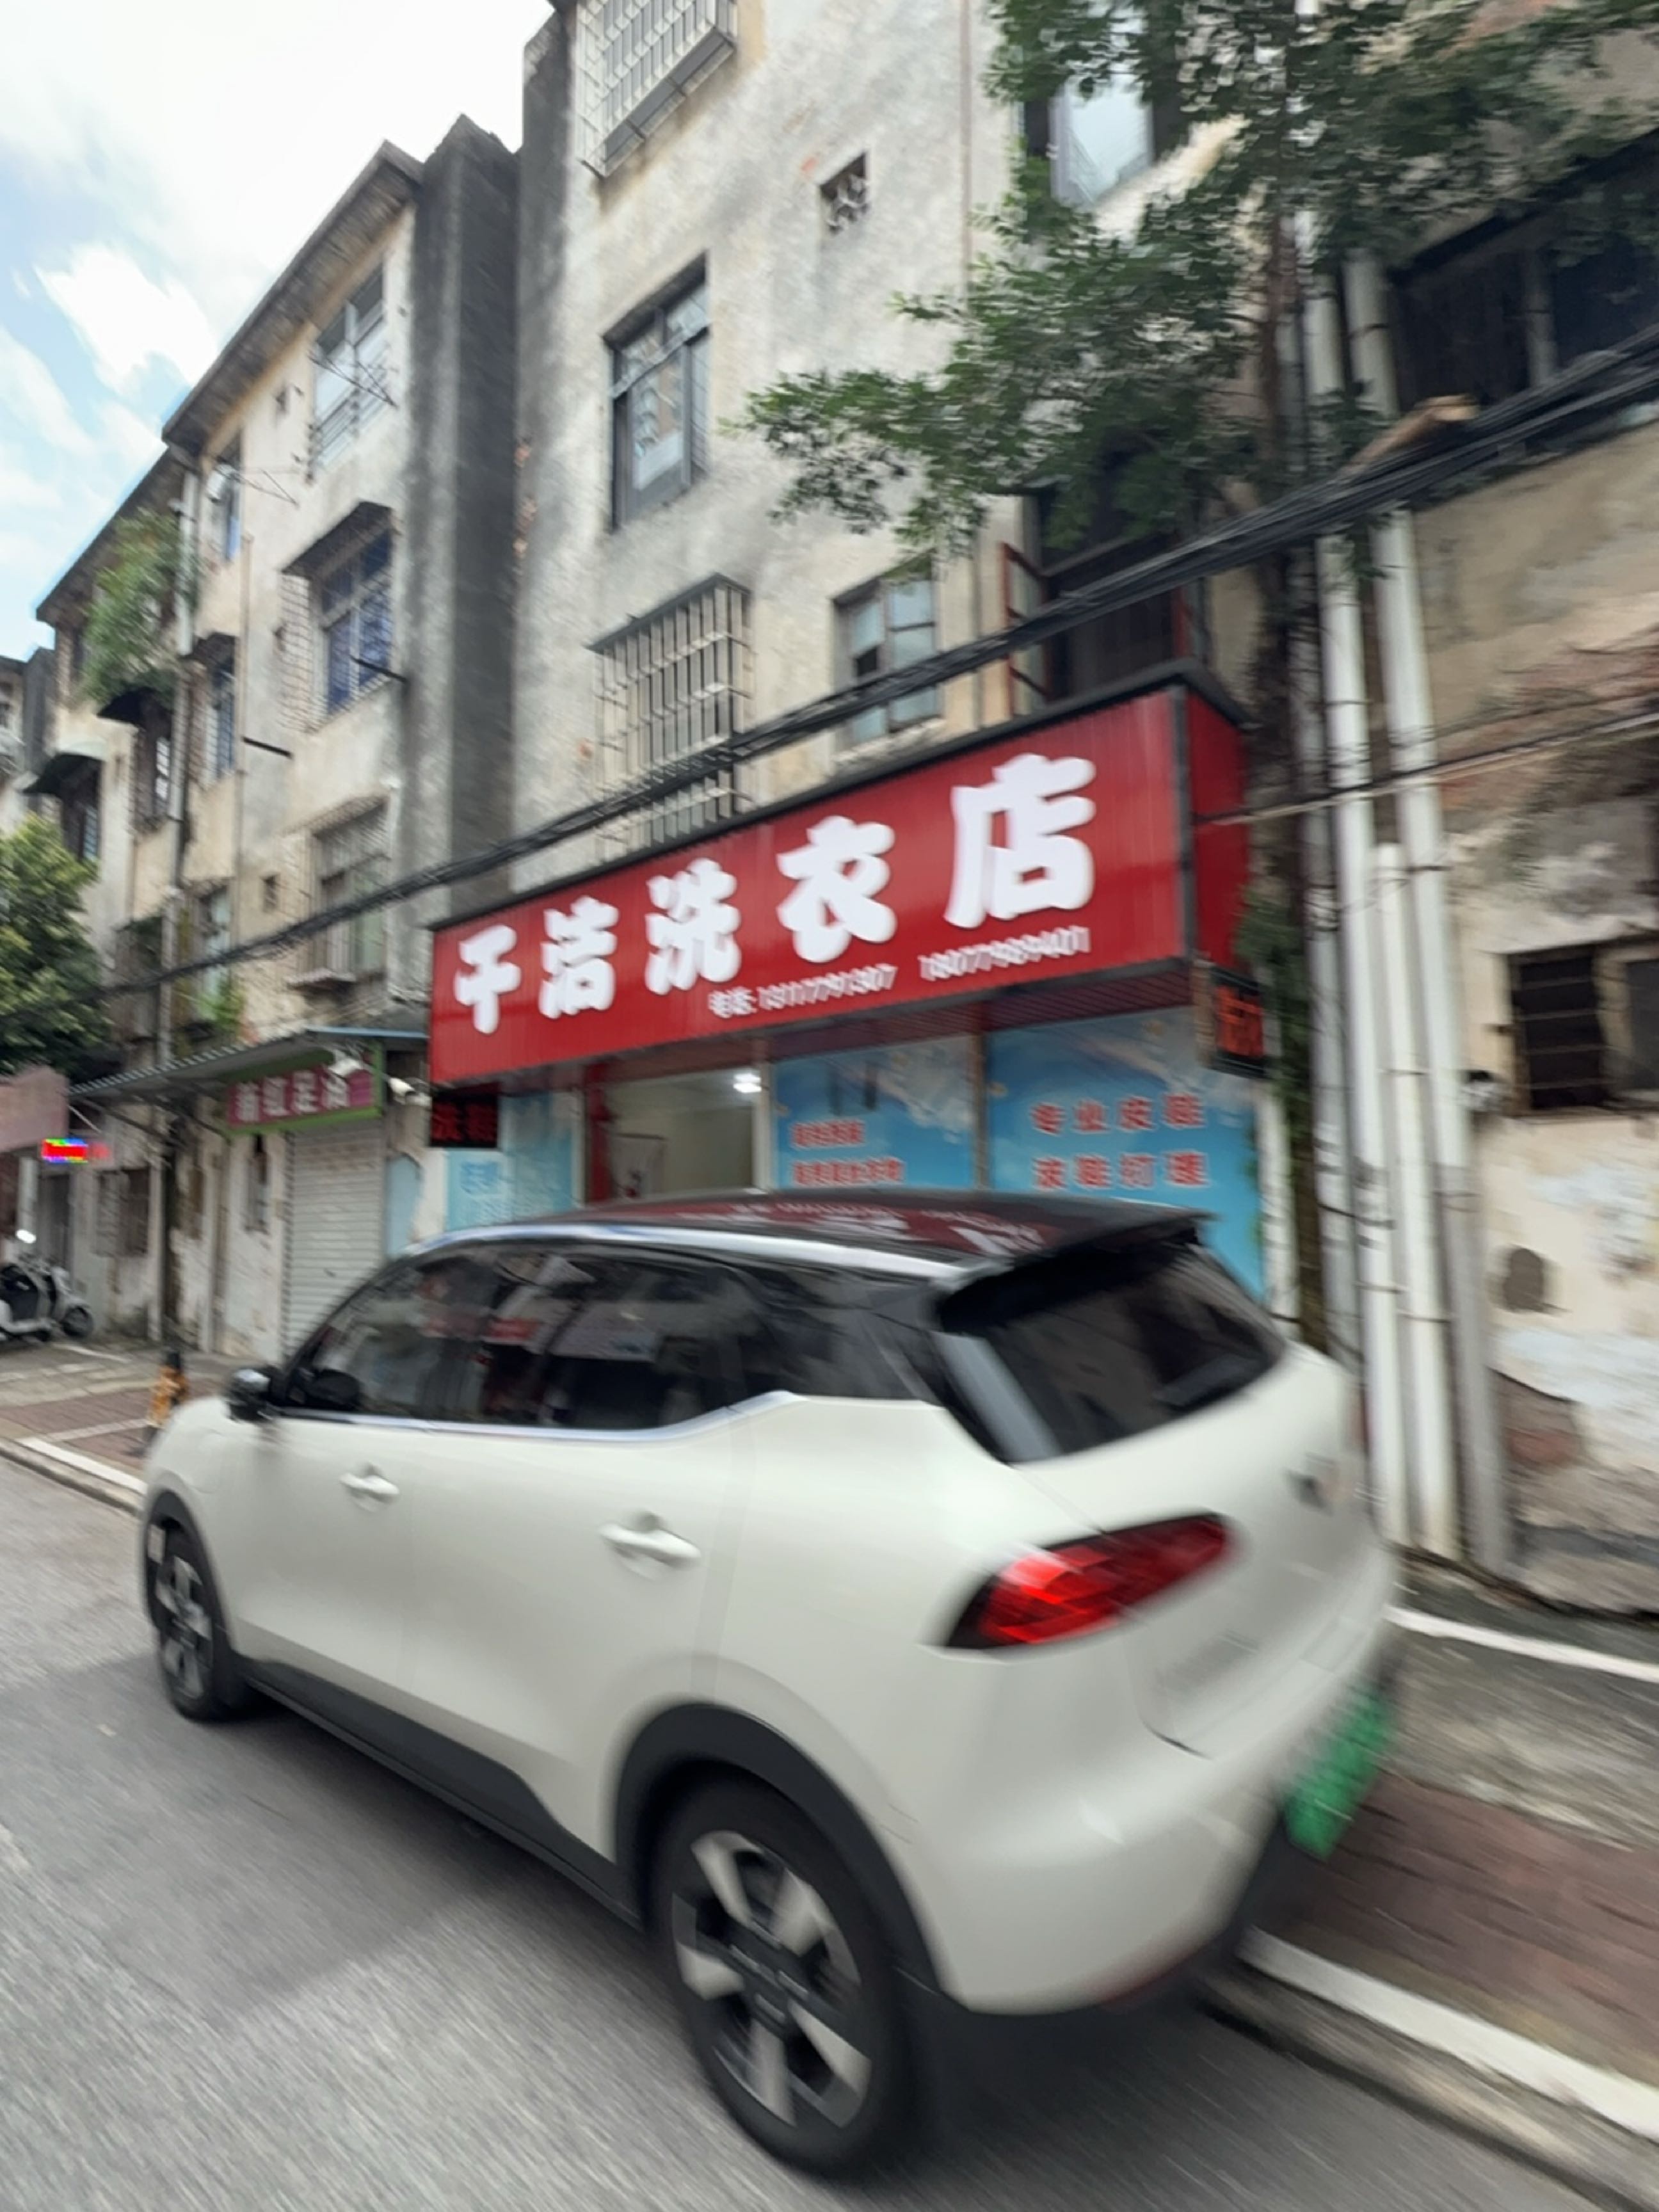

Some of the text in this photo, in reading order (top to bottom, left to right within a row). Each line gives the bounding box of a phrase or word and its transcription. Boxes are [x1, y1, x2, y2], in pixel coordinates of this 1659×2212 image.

[454, 753, 1096, 1034] 干洁洗衣店
